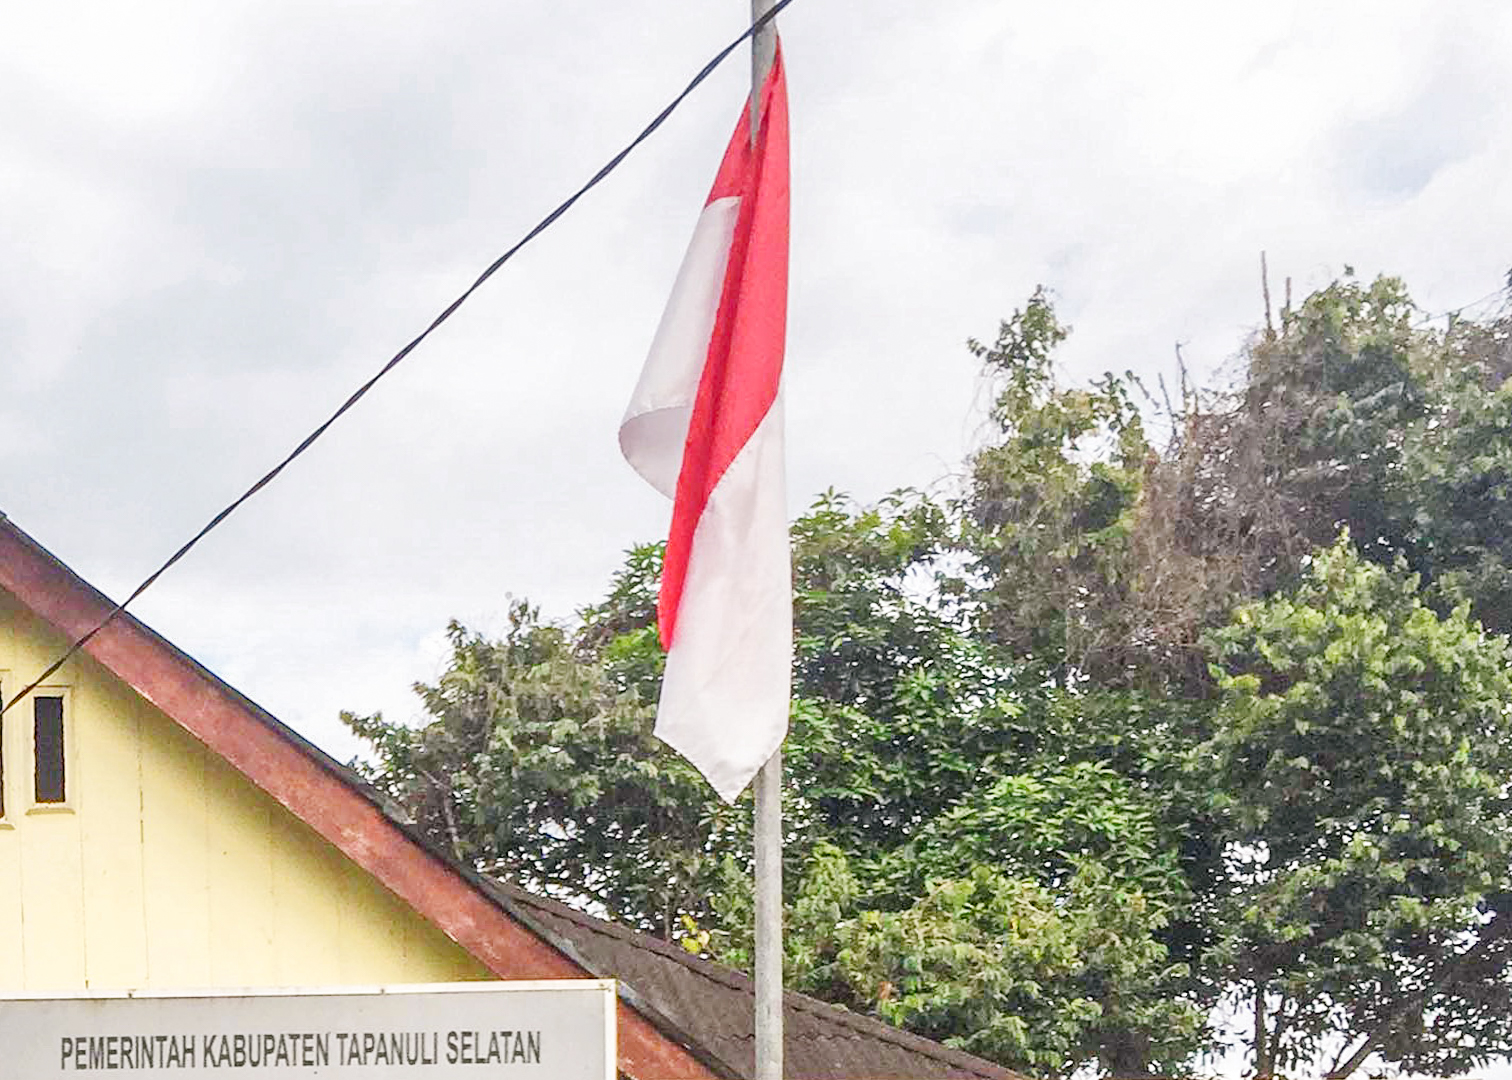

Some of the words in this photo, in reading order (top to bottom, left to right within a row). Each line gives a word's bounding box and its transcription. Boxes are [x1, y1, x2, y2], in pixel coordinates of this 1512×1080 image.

[61, 1035, 195, 1070] PEMERINTAH
[203, 1033, 329, 1068] KABUPATEN
[336, 1033, 439, 1066] TAPANULI
[446, 1031, 540, 1065] SELATAN
